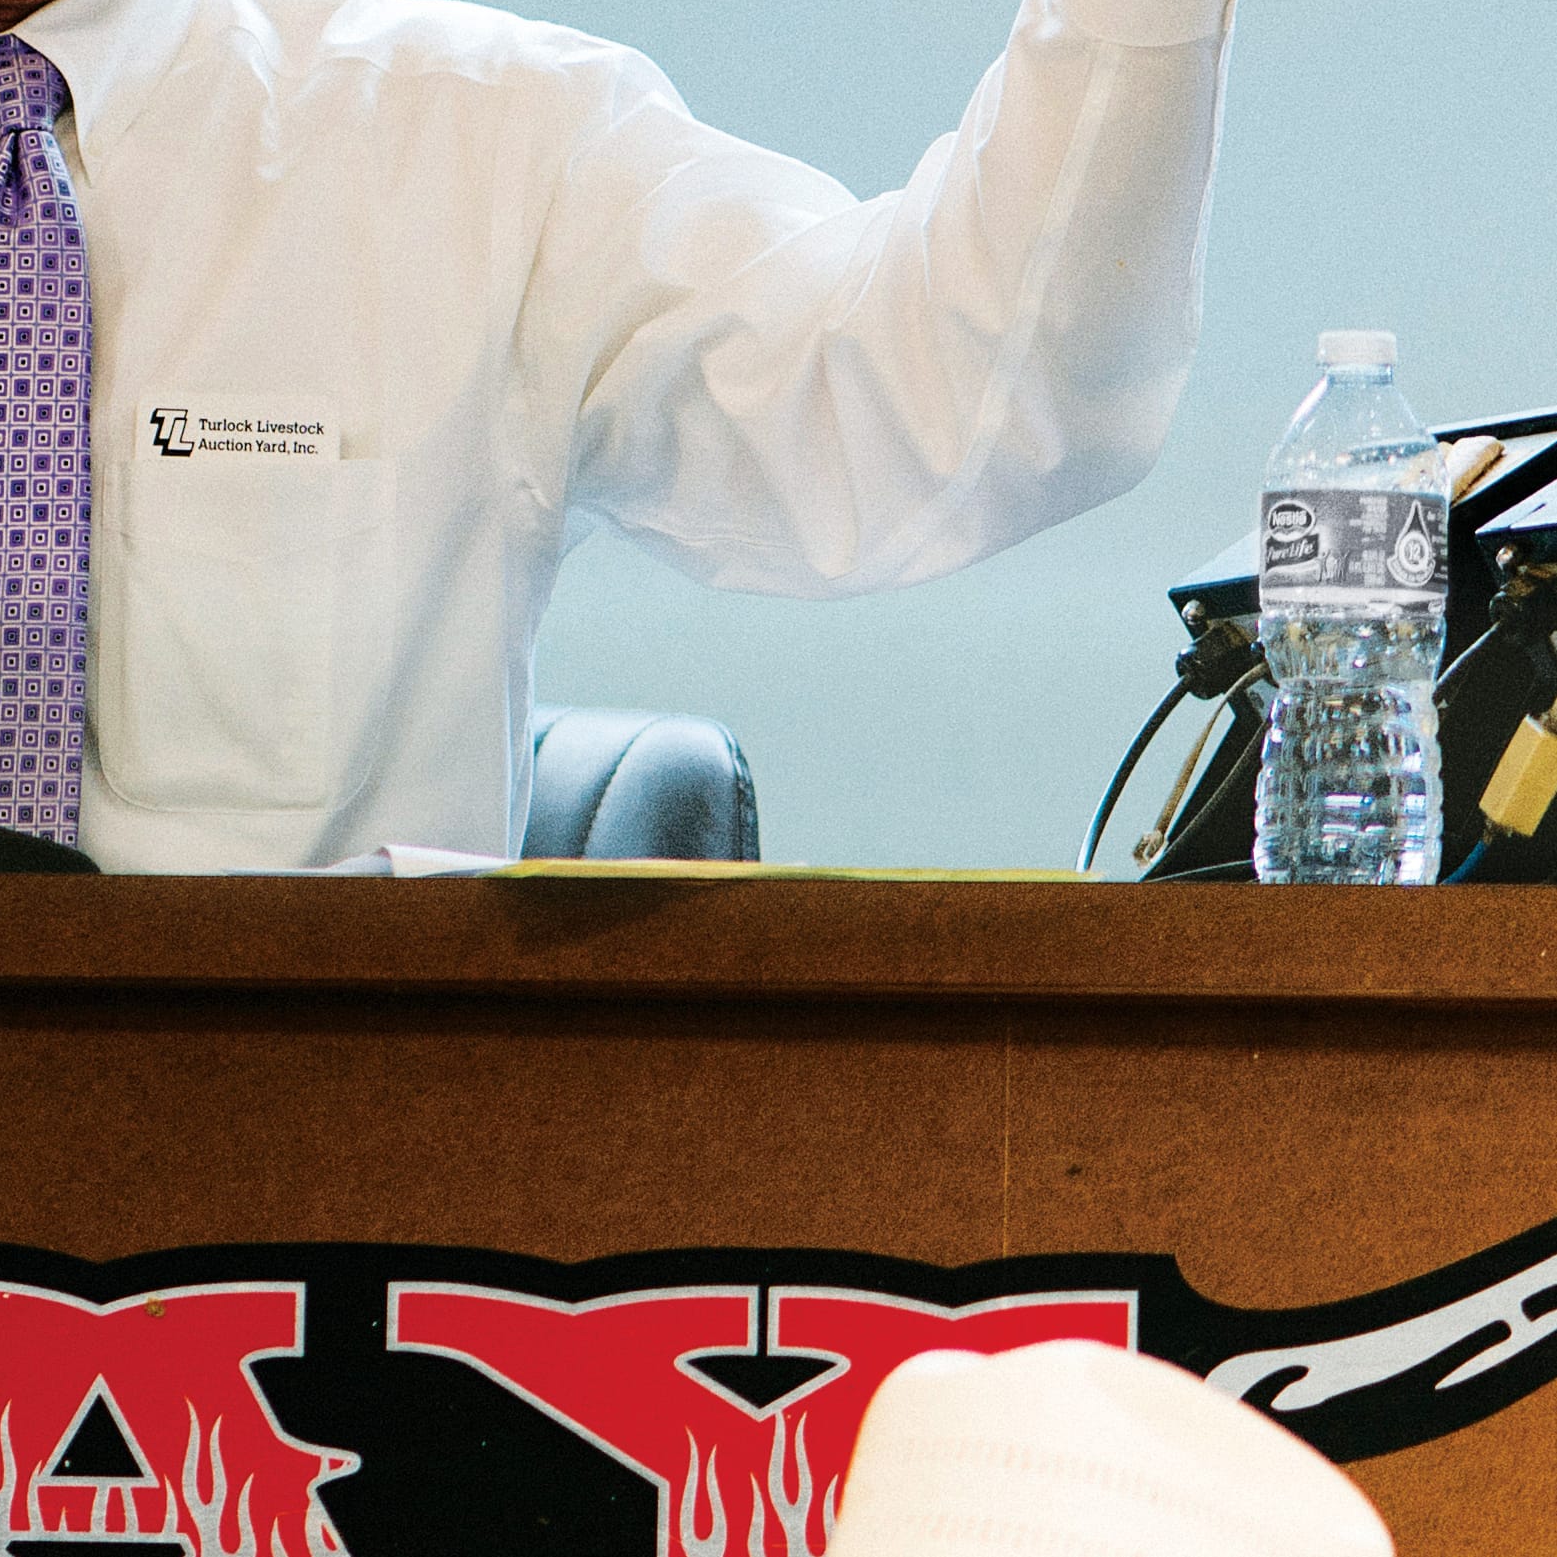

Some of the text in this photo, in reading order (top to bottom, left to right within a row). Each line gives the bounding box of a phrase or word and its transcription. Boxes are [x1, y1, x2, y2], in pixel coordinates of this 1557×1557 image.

[199, 418, 325, 435] Turlock Livestock
[198, 438, 319, 455] Auction Yard, Inc.
